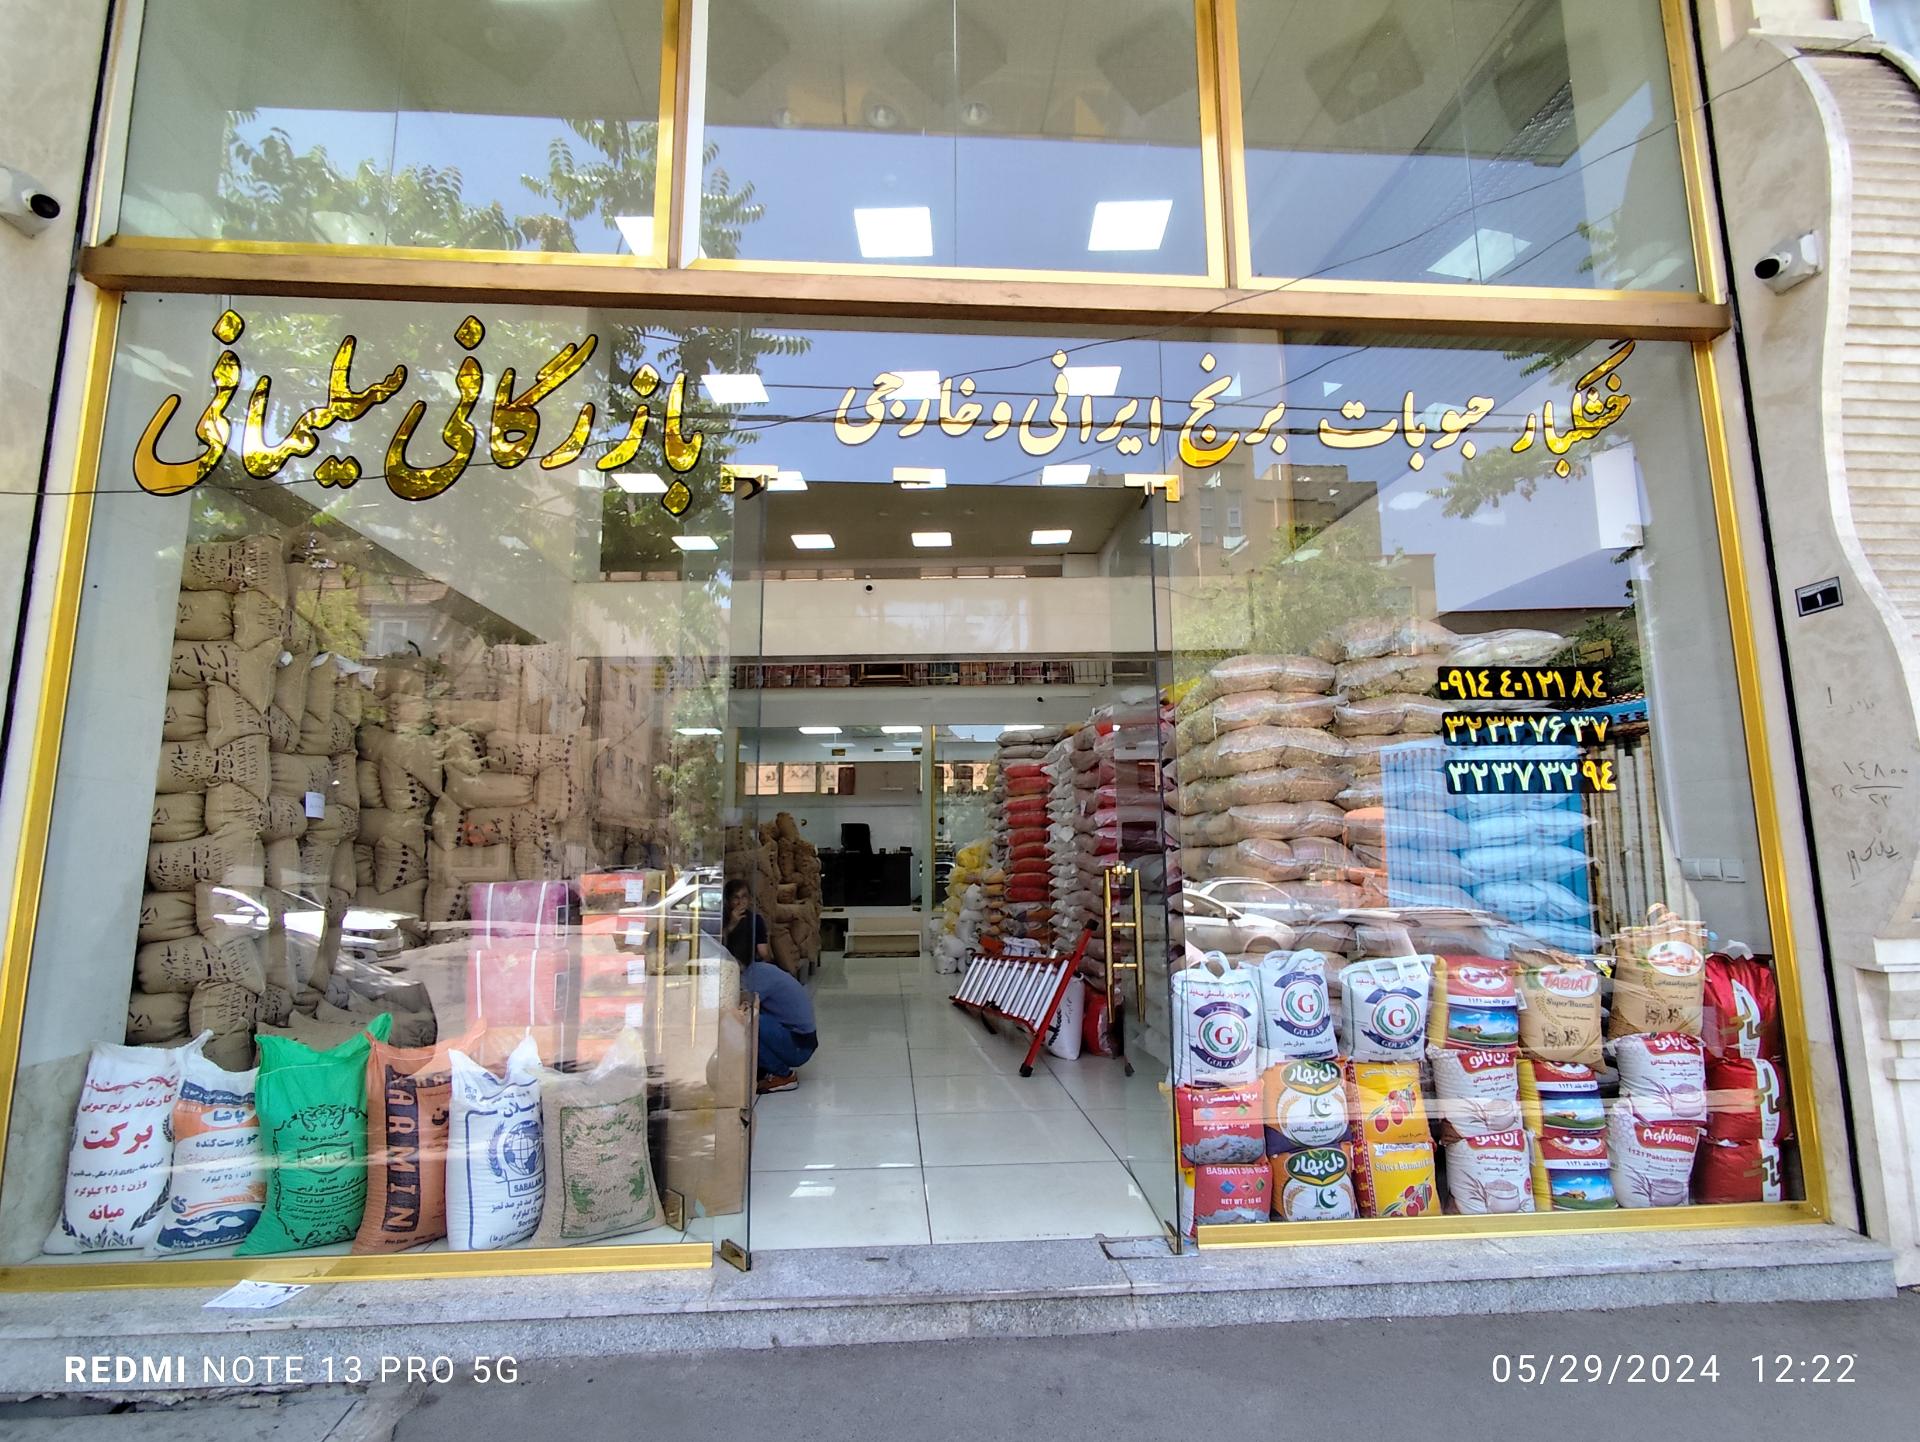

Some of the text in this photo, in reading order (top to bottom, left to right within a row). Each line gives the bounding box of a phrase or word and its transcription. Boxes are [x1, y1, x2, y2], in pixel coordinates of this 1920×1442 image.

[133, 308, 703, 516] بازرگانی سلیمانی
[833, 338, 1636, 479] خشکبار حبوبات برنج ایرانی و خارجی
[1544, 971, 1595, 992] TABIAT
[1297, 994, 1314, 1014] G
[1388, 1009, 1406, 1028] G
[1215, 1026, 1233, 1046] G
[1293, 1025, 1325, 1037] GOLZAR
[1288, 1065, 1319, 1085] بهار
[1319, 1063, 1338, 1082] دل
[134, 1093, 176, 1108] کارخانه
[213, 1110, 246, 1123] پاشا
[83, 1121, 153, 1155] برکت
[1643, 1127, 1696, 1146] Aghbanoo
[1206, 1167, 1241, 1176] BASMATI
[1292, 1151, 1345, 1176] دل بهار
[74, 1186, 102, 1198] کیلوگرم
[104, 1184, 118, 1194] ۲۵
[127, 1180, 148, 1192] وزن
[88, 1204, 125, 1223] میانه
